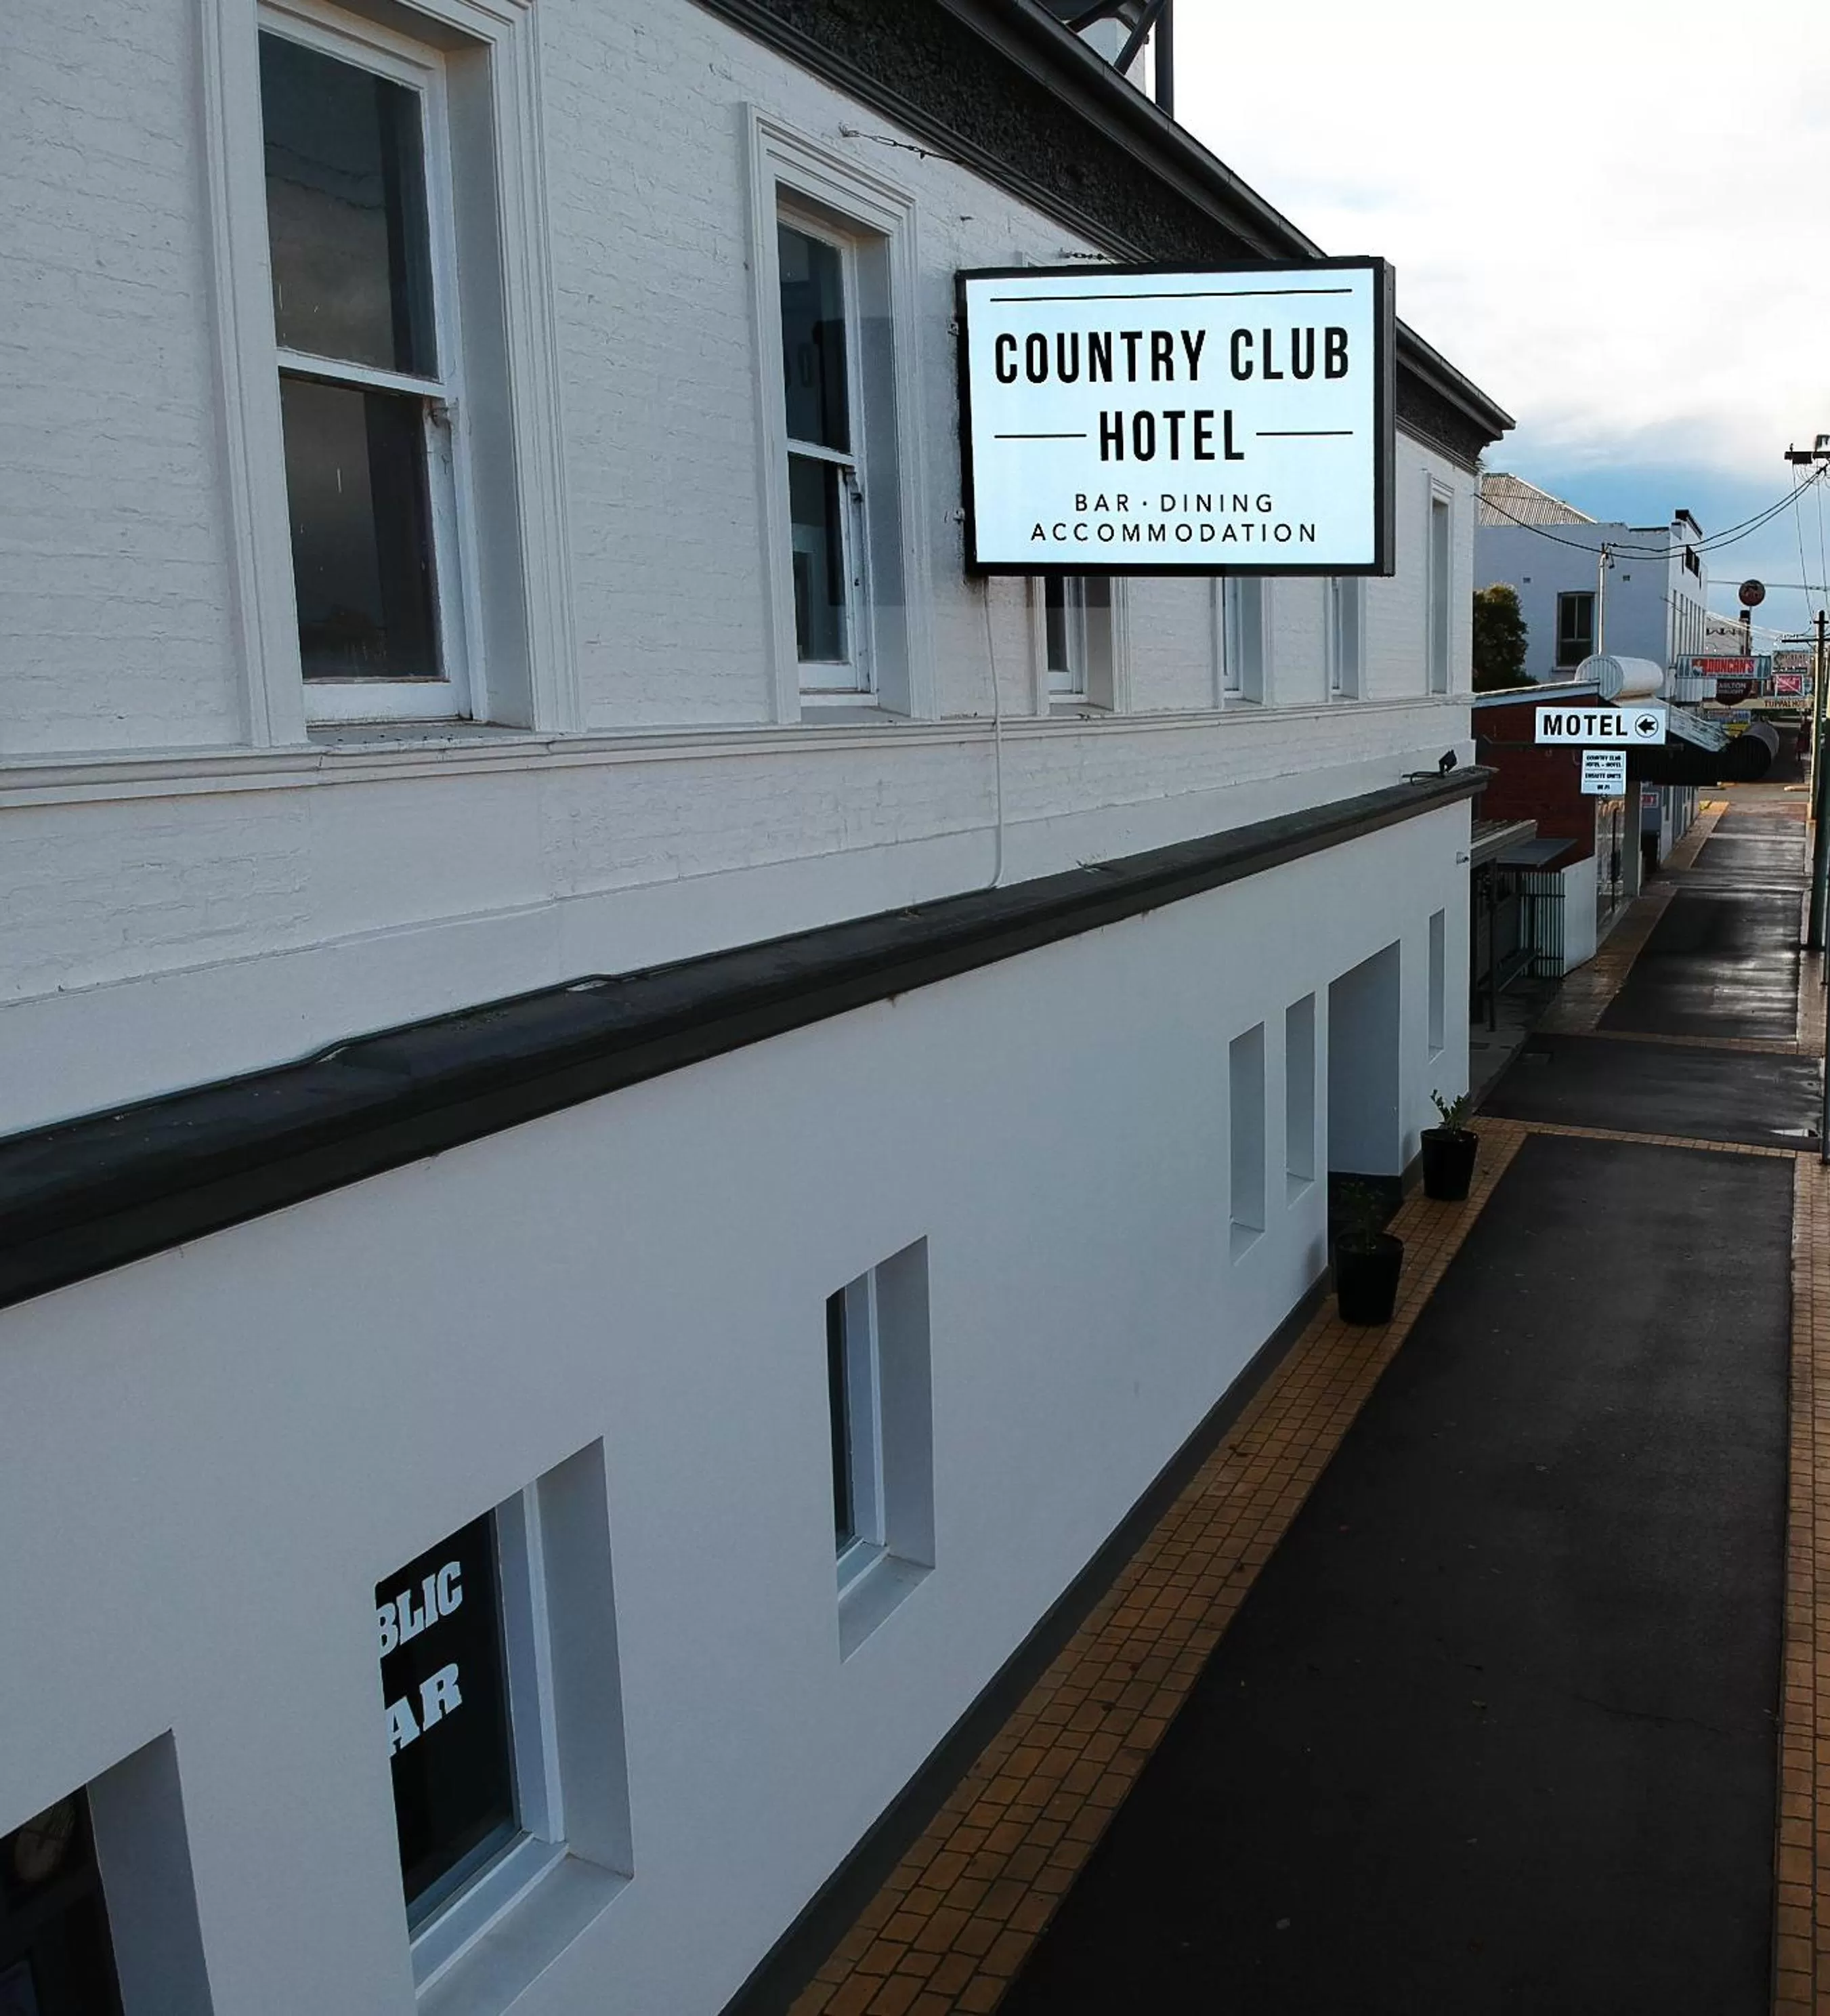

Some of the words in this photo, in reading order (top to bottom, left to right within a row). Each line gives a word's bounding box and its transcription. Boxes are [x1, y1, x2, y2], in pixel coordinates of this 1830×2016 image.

[994, 330, 1206, 384] COUNTRY
[1231, 327, 1349, 381] CLUB
[1100, 409, 1245, 461] HOTEL
[1075, 495, 1130, 513] BAR
[1160, 493, 1273, 513] DINING
[1030, 523, 1316, 543] ACCOMMODATION
[1544, 715, 1627, 736] MOTEL
